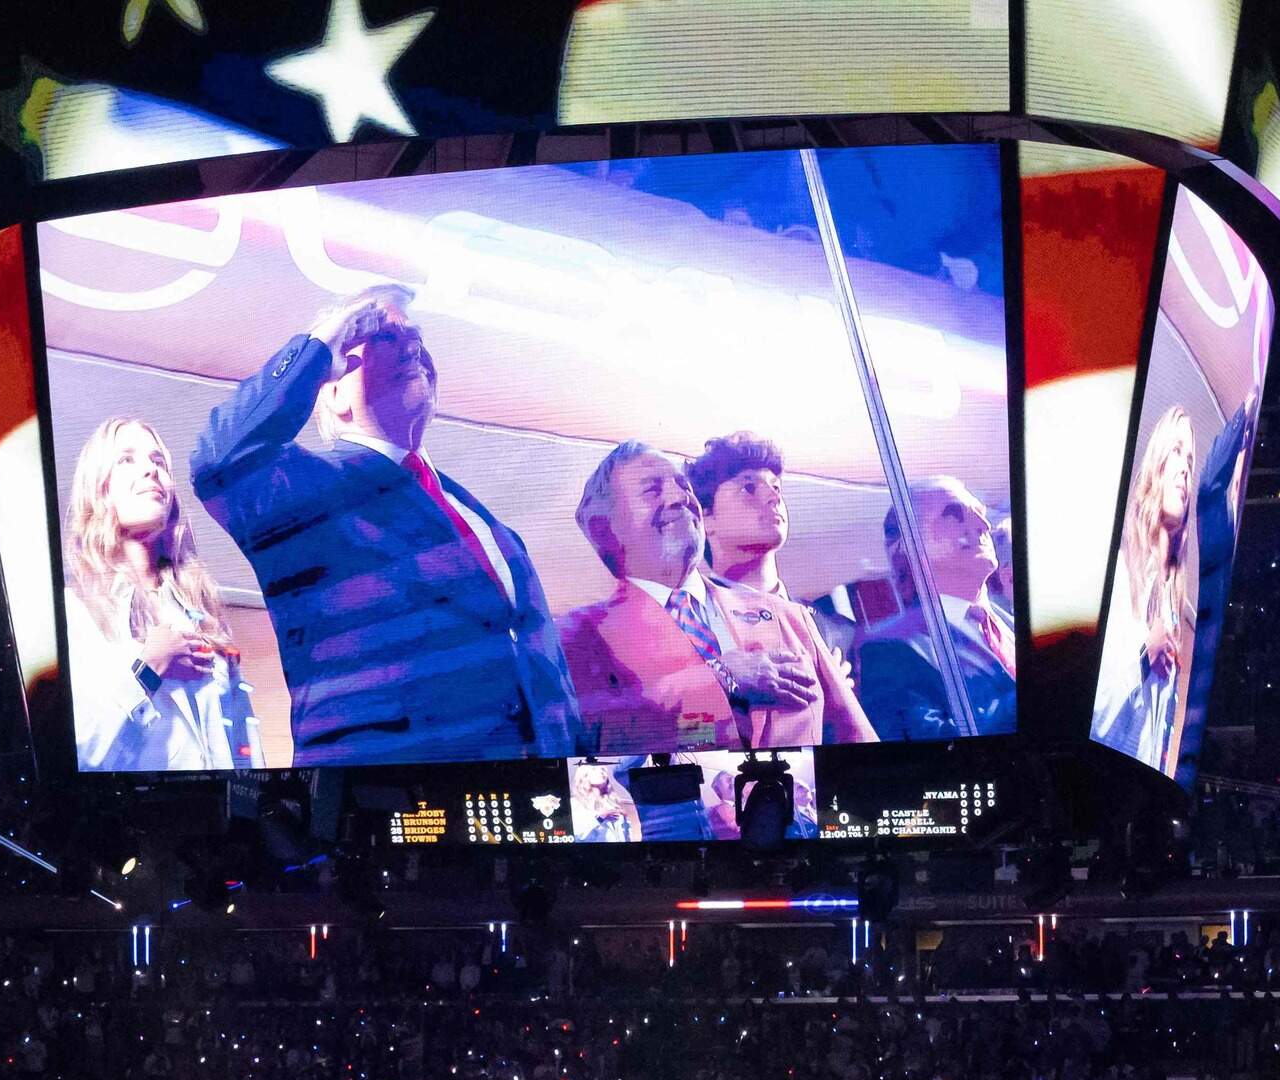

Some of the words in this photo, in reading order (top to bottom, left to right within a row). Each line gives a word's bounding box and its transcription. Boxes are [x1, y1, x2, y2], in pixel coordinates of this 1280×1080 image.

[390, 818, 401, 826] 11
[403, 818, 446, 826] BRUNSON
[839, 812, 849, 824] 0
[543, 818, 553, 830] 0
[404, 826, 445, 834] BRIDGES
[892, 826, 956, 834] CHAMPAGNIE
[548, 835, 574, 843] 12:00
